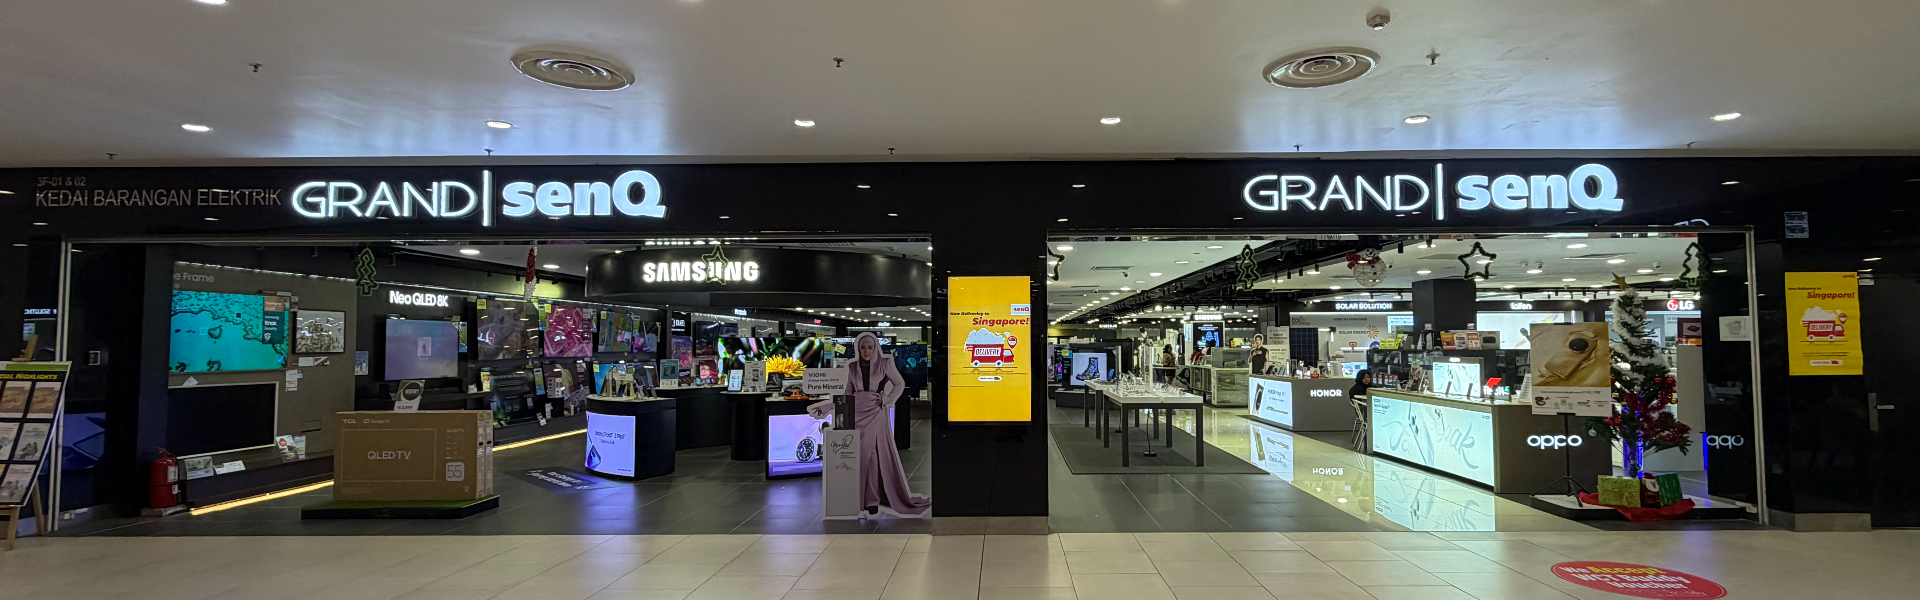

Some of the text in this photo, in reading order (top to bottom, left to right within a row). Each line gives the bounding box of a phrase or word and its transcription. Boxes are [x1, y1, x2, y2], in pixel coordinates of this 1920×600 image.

[36, 176, 86, 187] 3F-01 & 02
[1243, 163, 1624, 212] GRAND senQ
[36, 189, 282, 207] KEDAI BARANGAN ELEKTRIK
[291, 169, 667, 219] GRAND senQ
[642, 261, 760, 283] SAMSUNG
[183, 272, 215, 283] Frame
[389, 290, 449, 308] Neo QLED 8K
[1806, 291, 1855, 300] Singapore!
[1335, 302, 1393, 311] SOLAR SOLUTION
[1678, 300, 1696, 310] LG
[972, 316, 1030, 327] Singapore!
[1809, 322, 1834, 331] DELIVERY
[975, 347, 1000, 356] DELIVERY
[807, 383, 845, 391] Pure Mineral
[1310, 389, 1343, 397] HONOR
[1526, 434, 1583, 450] oppo
[367, 450, 412, 460] QLED TV
[446, 464, 463, 479] 55
[1558, 566, 1667, 575] We Accept
[1570, 574, 1692, 584] WCT Buddy
[1606, 581, 1688, 589] Voucher
